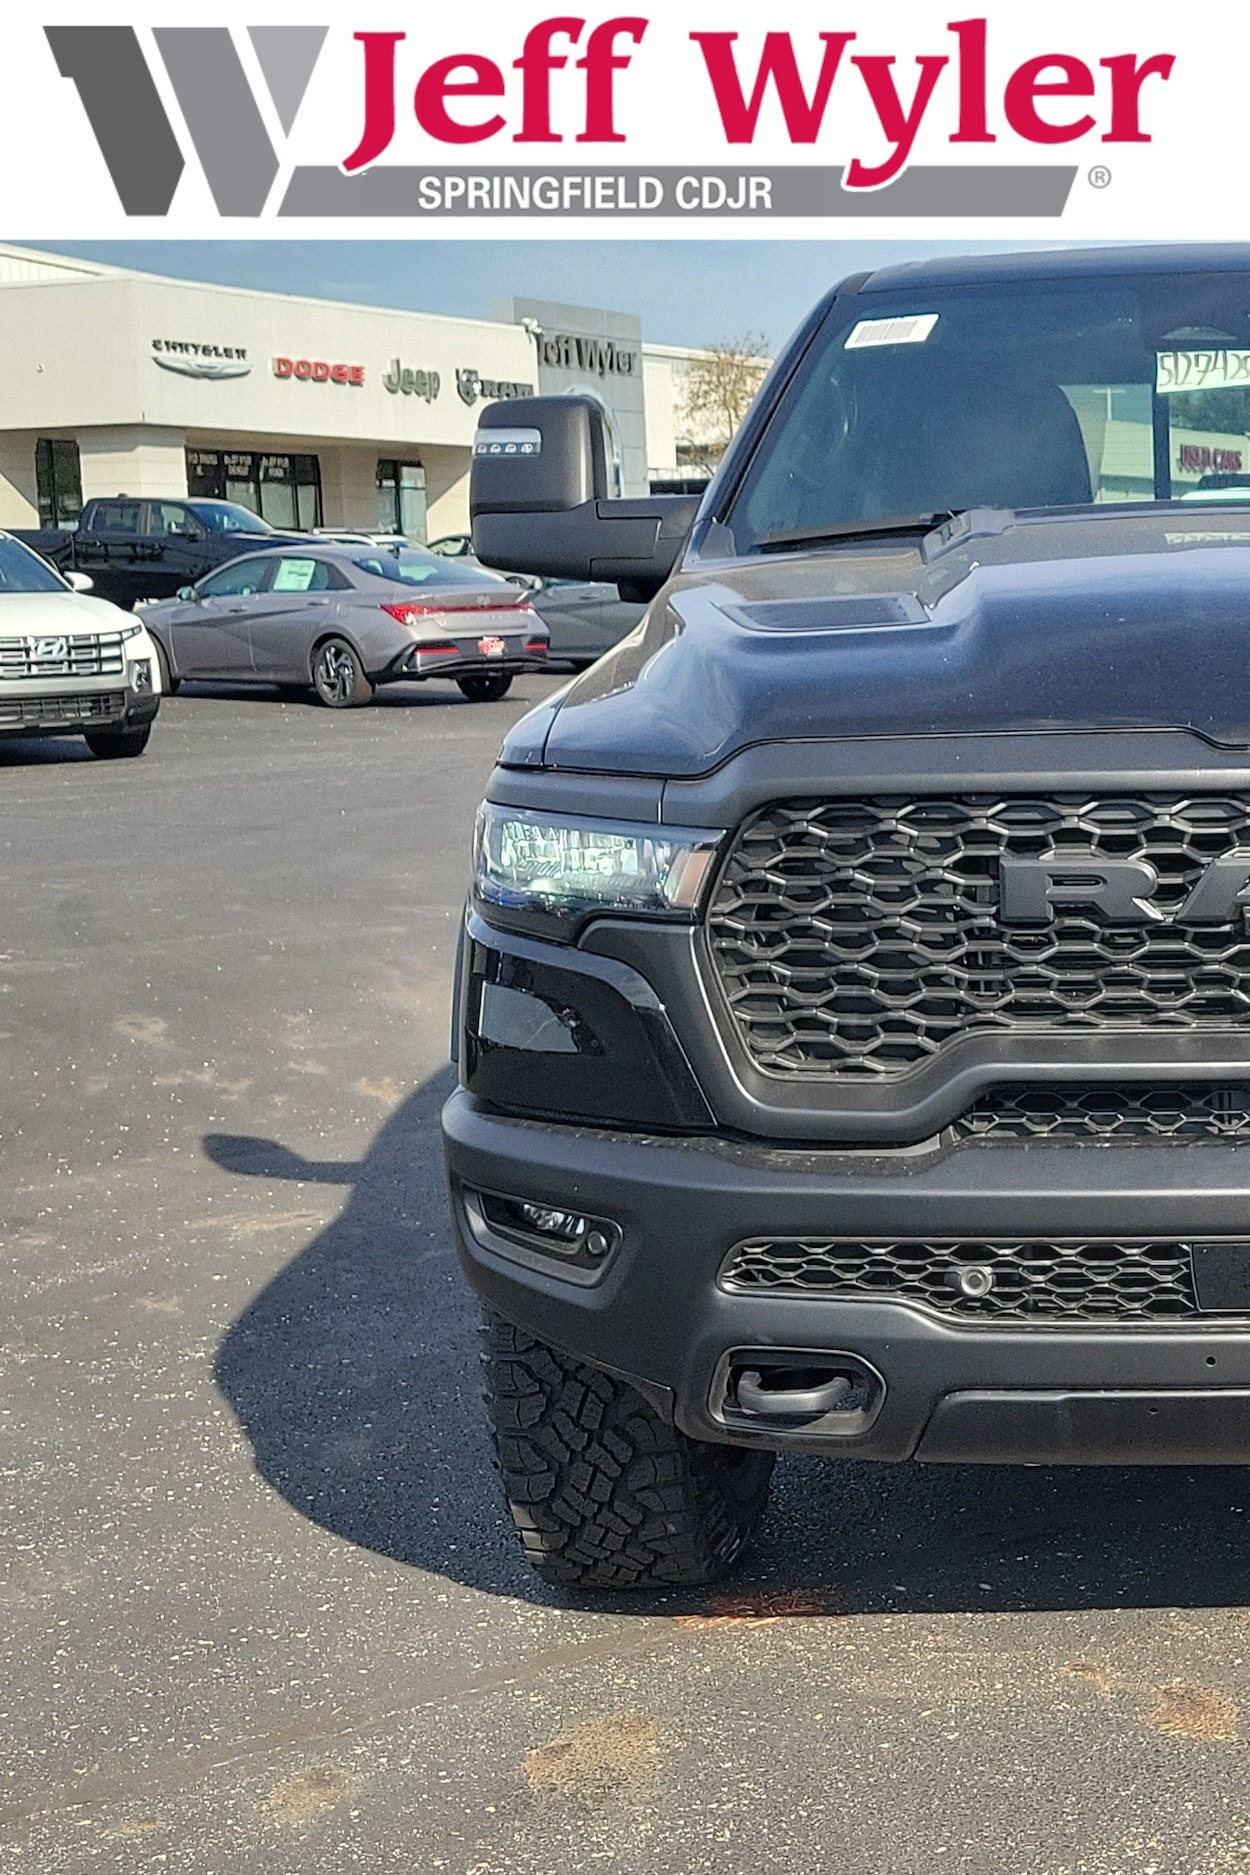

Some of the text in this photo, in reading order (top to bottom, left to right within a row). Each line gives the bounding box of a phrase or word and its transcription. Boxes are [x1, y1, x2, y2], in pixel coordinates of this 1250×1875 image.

[151, 339, 248, 361] CHRYSLER
[575, 338, 638, 380] Wyler
[274, 356, 366, 387] DODGE
[384, 358, 441, 404] Jeep
